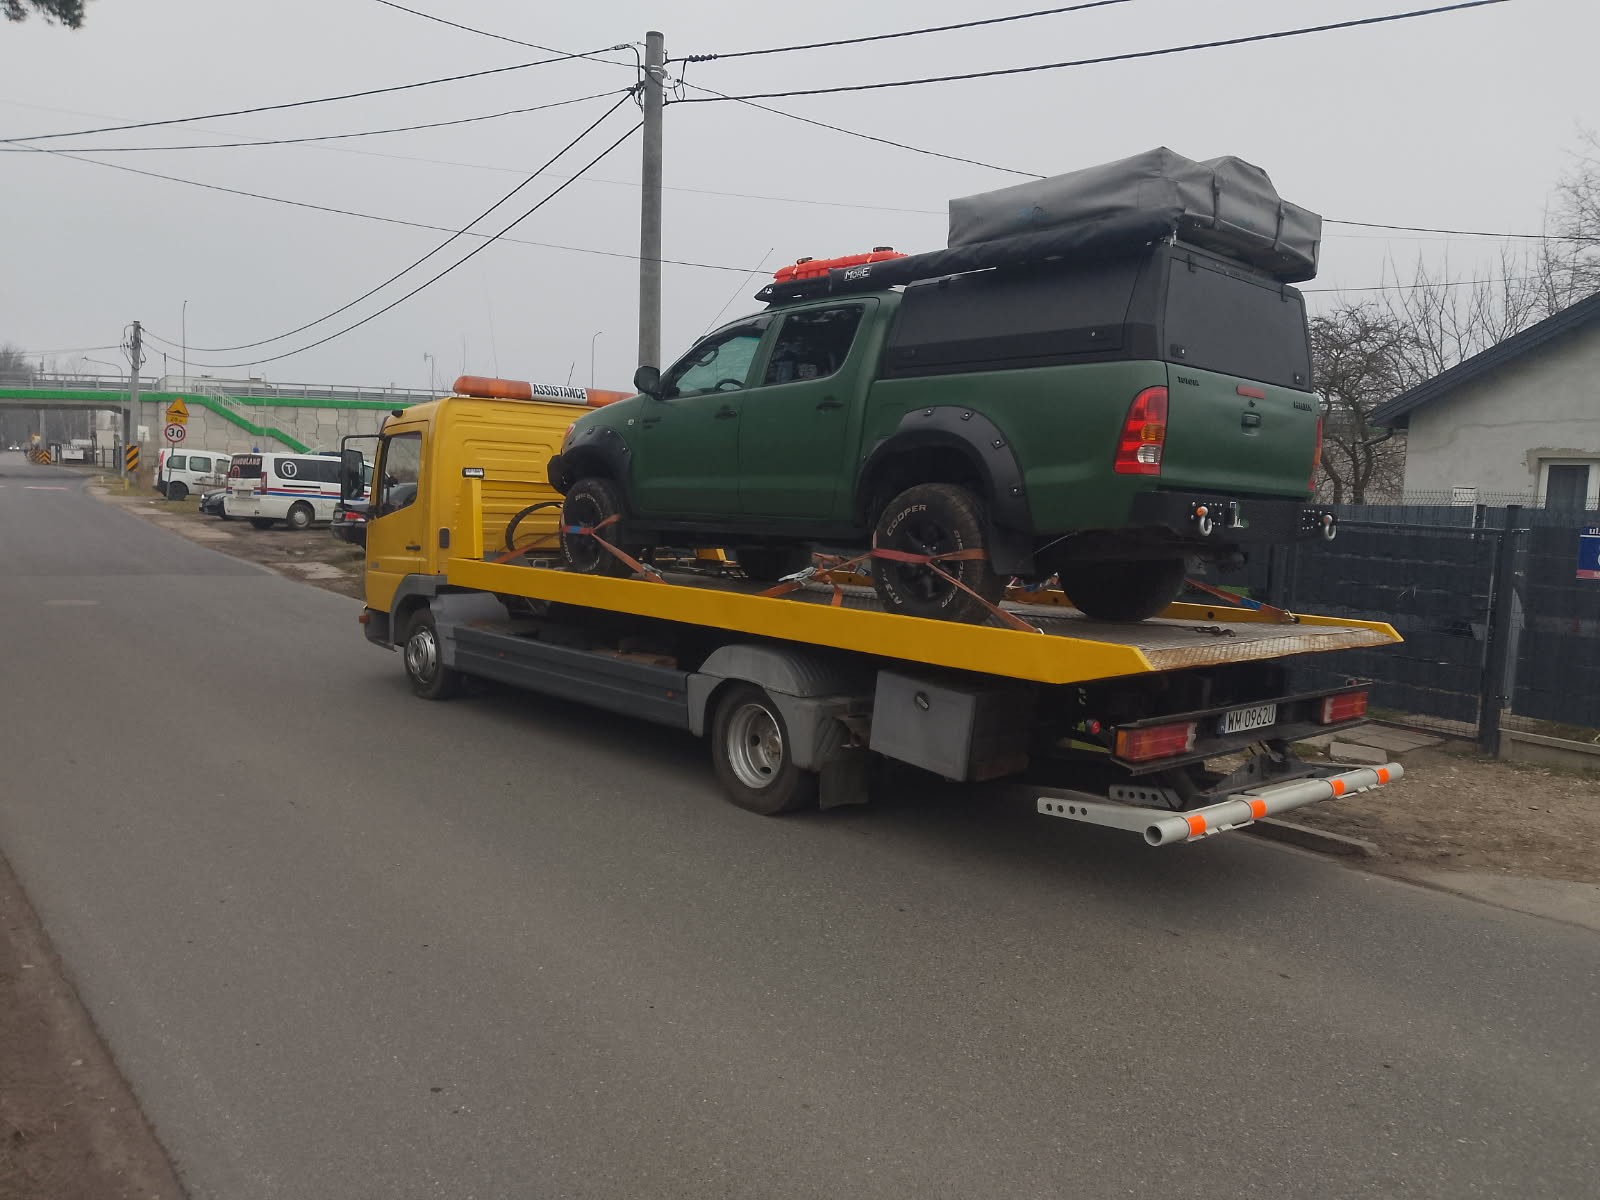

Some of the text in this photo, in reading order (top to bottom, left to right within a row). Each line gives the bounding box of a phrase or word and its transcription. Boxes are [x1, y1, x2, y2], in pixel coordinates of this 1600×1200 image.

[533, 383, 587, 400] ASSISTANCE
[168, 427, 183, 439] 30
[285, 464, 293, 475] T
[886, 504, 927, 537] COOPER
[1228, 704, 1275, 731] WM 0962U
